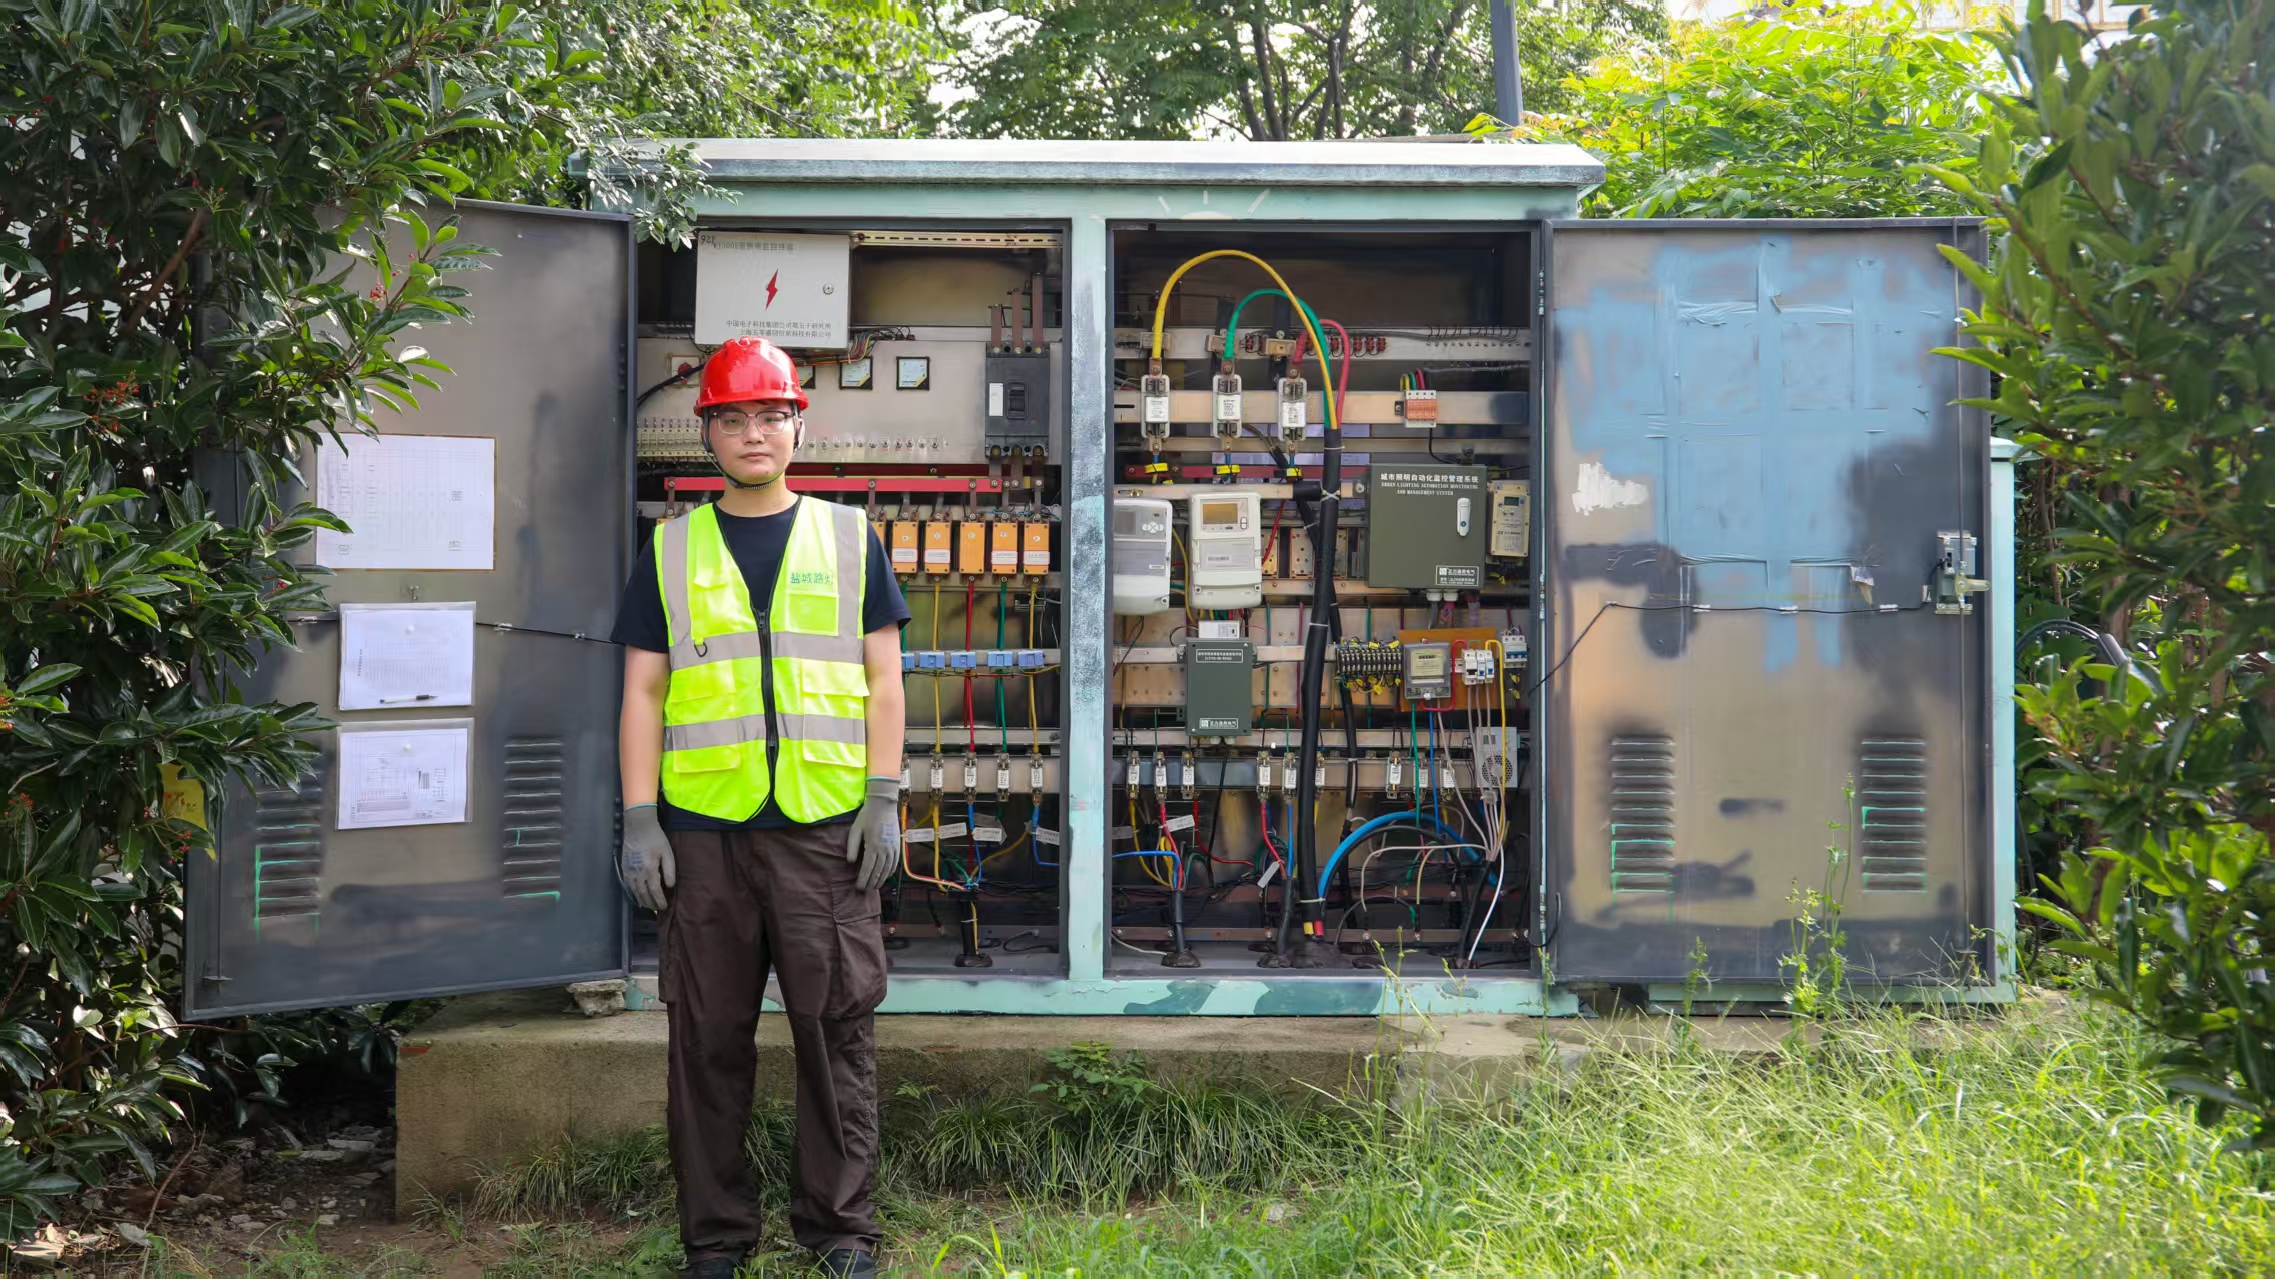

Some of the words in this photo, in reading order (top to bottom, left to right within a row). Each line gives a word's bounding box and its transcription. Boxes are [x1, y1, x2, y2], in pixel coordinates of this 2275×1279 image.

[1380, 473, 1479, 483] 城市照明自动化监控管理系统
